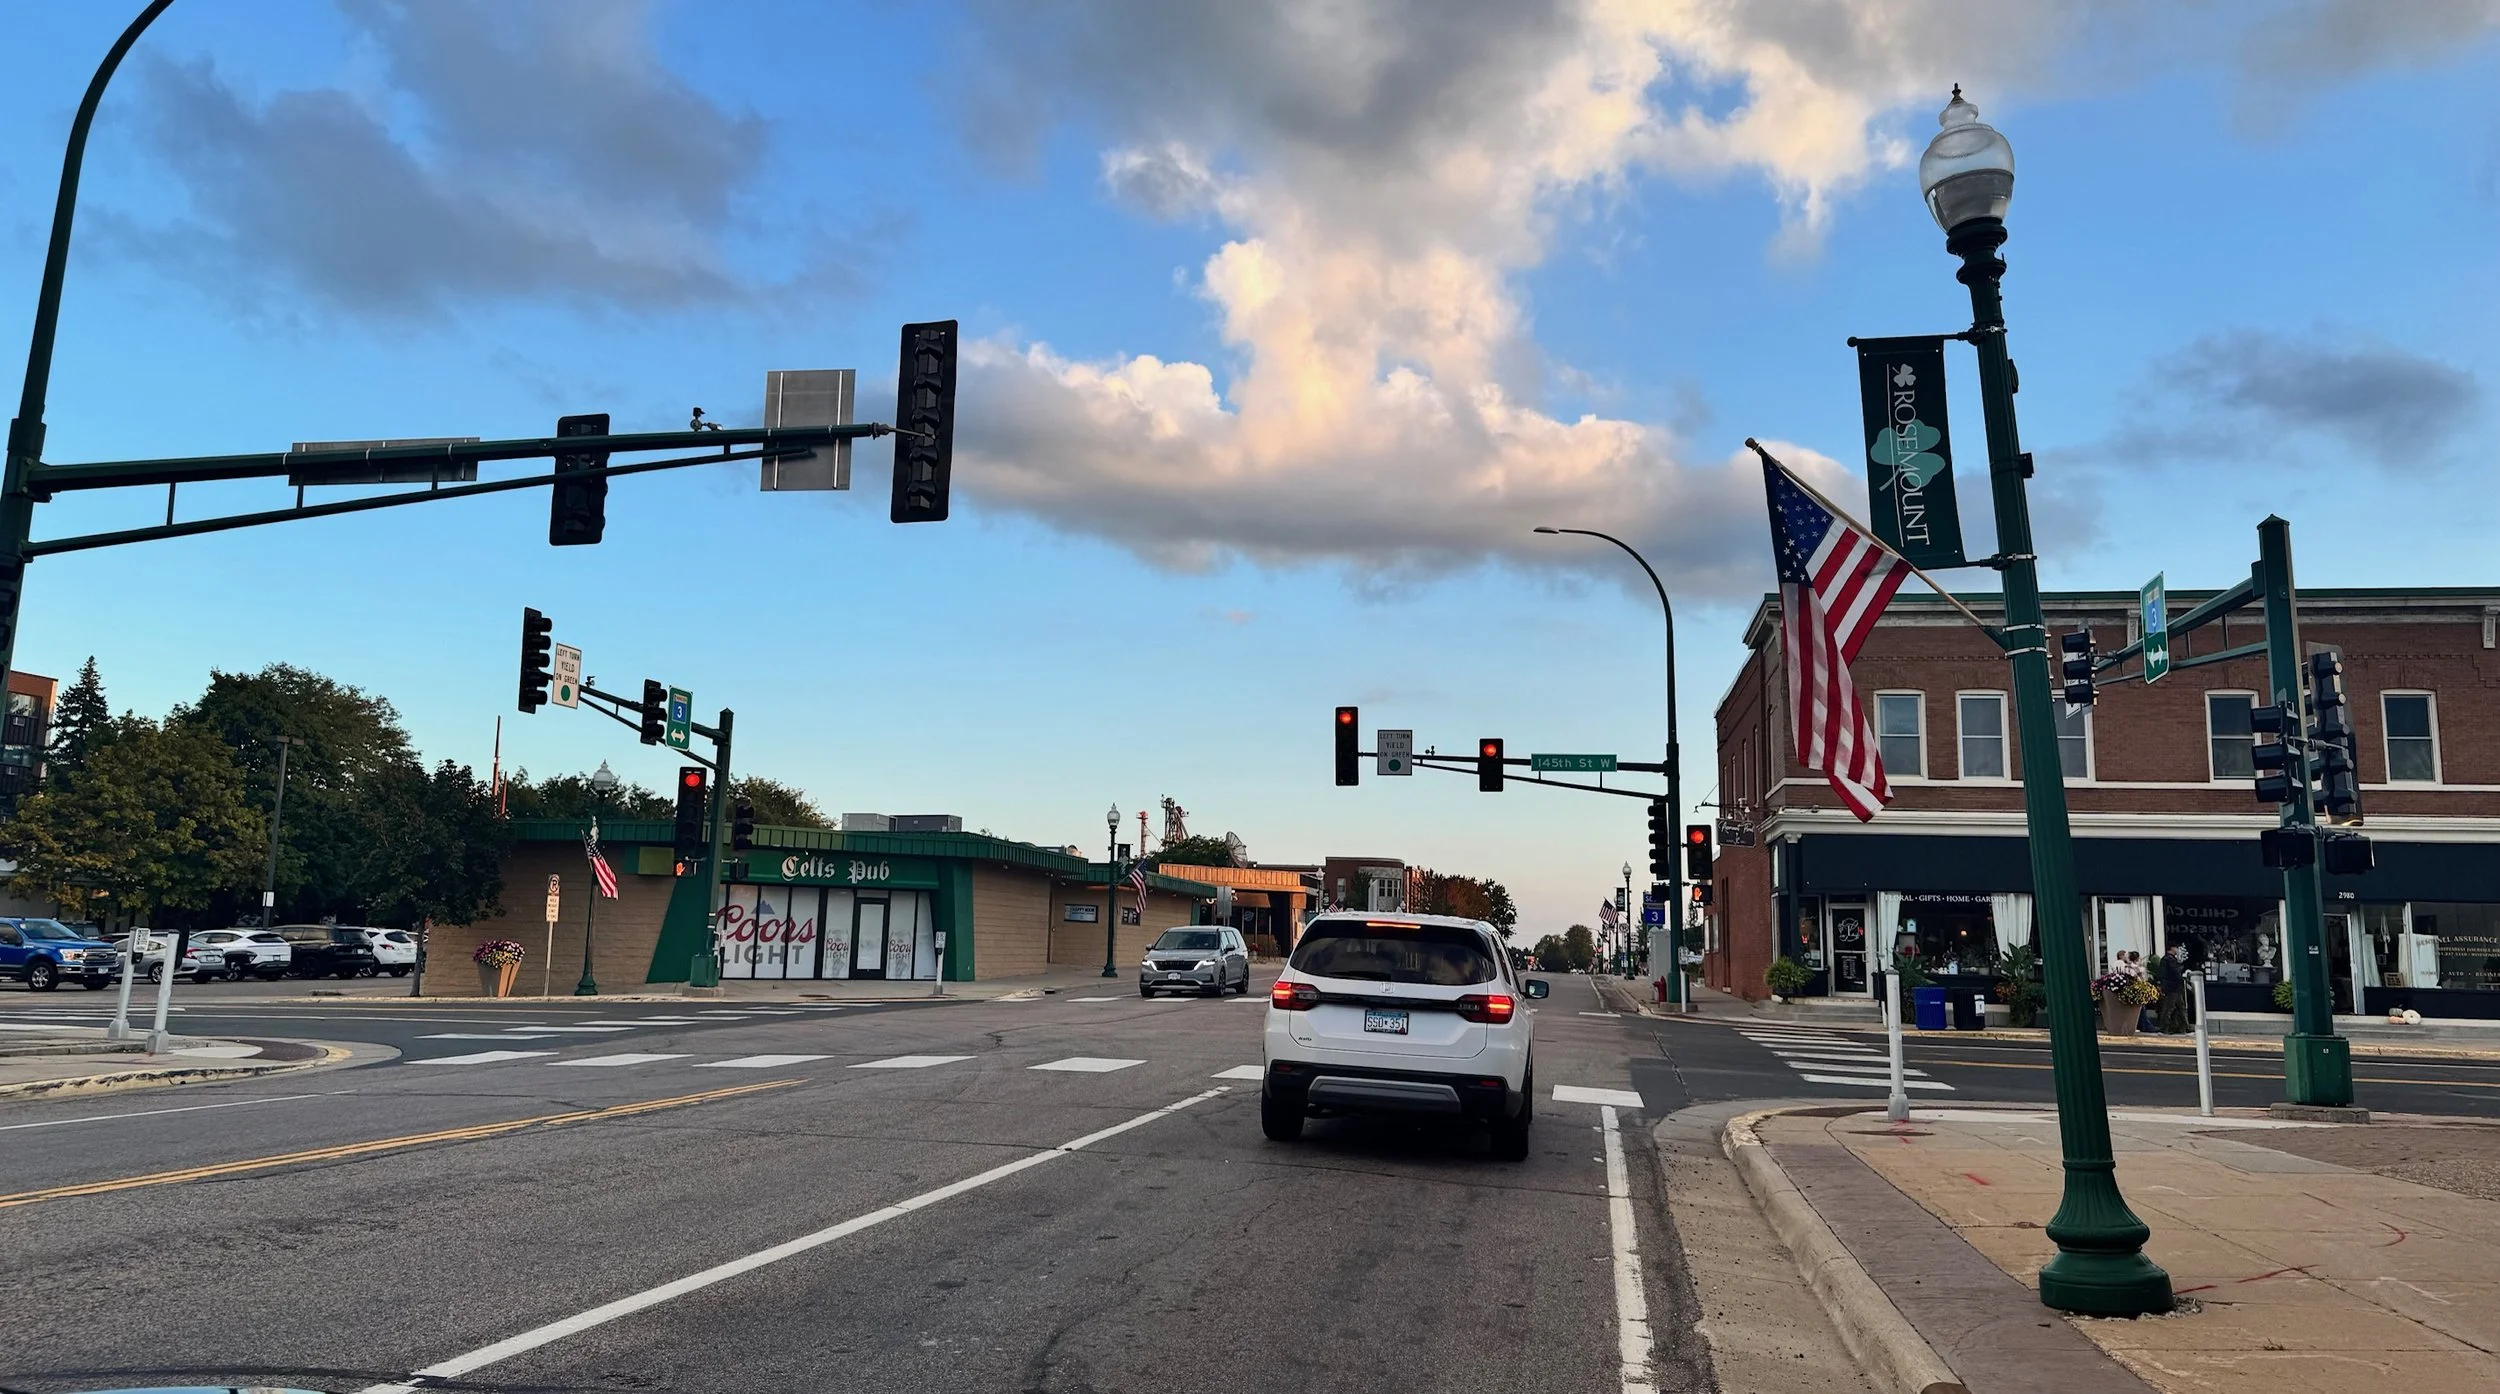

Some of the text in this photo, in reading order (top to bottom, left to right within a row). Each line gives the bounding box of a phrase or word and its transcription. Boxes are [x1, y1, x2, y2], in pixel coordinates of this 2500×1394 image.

[1893, 390, 1930, 546] ROSEMOUNT
[2151, 607, 2158, 628] 3
[557, 648, 580, 661] LEFT TURN
[561, 661, 576, 673] YIELD
[555, 672, 578, 686] ON GREEN
[676, 705, 683, 719] 3
[1379, 732, 1411, 740] LEFT TURN
[1385, 741, 1405, 749] YIELD
[1391, 751, 1411, 759] GREEN
[1538, 758, 1611, 768] 145th St W
[781, 855, 890, 885] Celts Pub
[1918, 894, 1942, 902] GIFTS
[1946, 895, 1970, 903] HOME
[1974, 895, 2007, 903] GARDEN
[1651, 911, 1659, 922] 3
[715, 904, 816, 944] Coors
